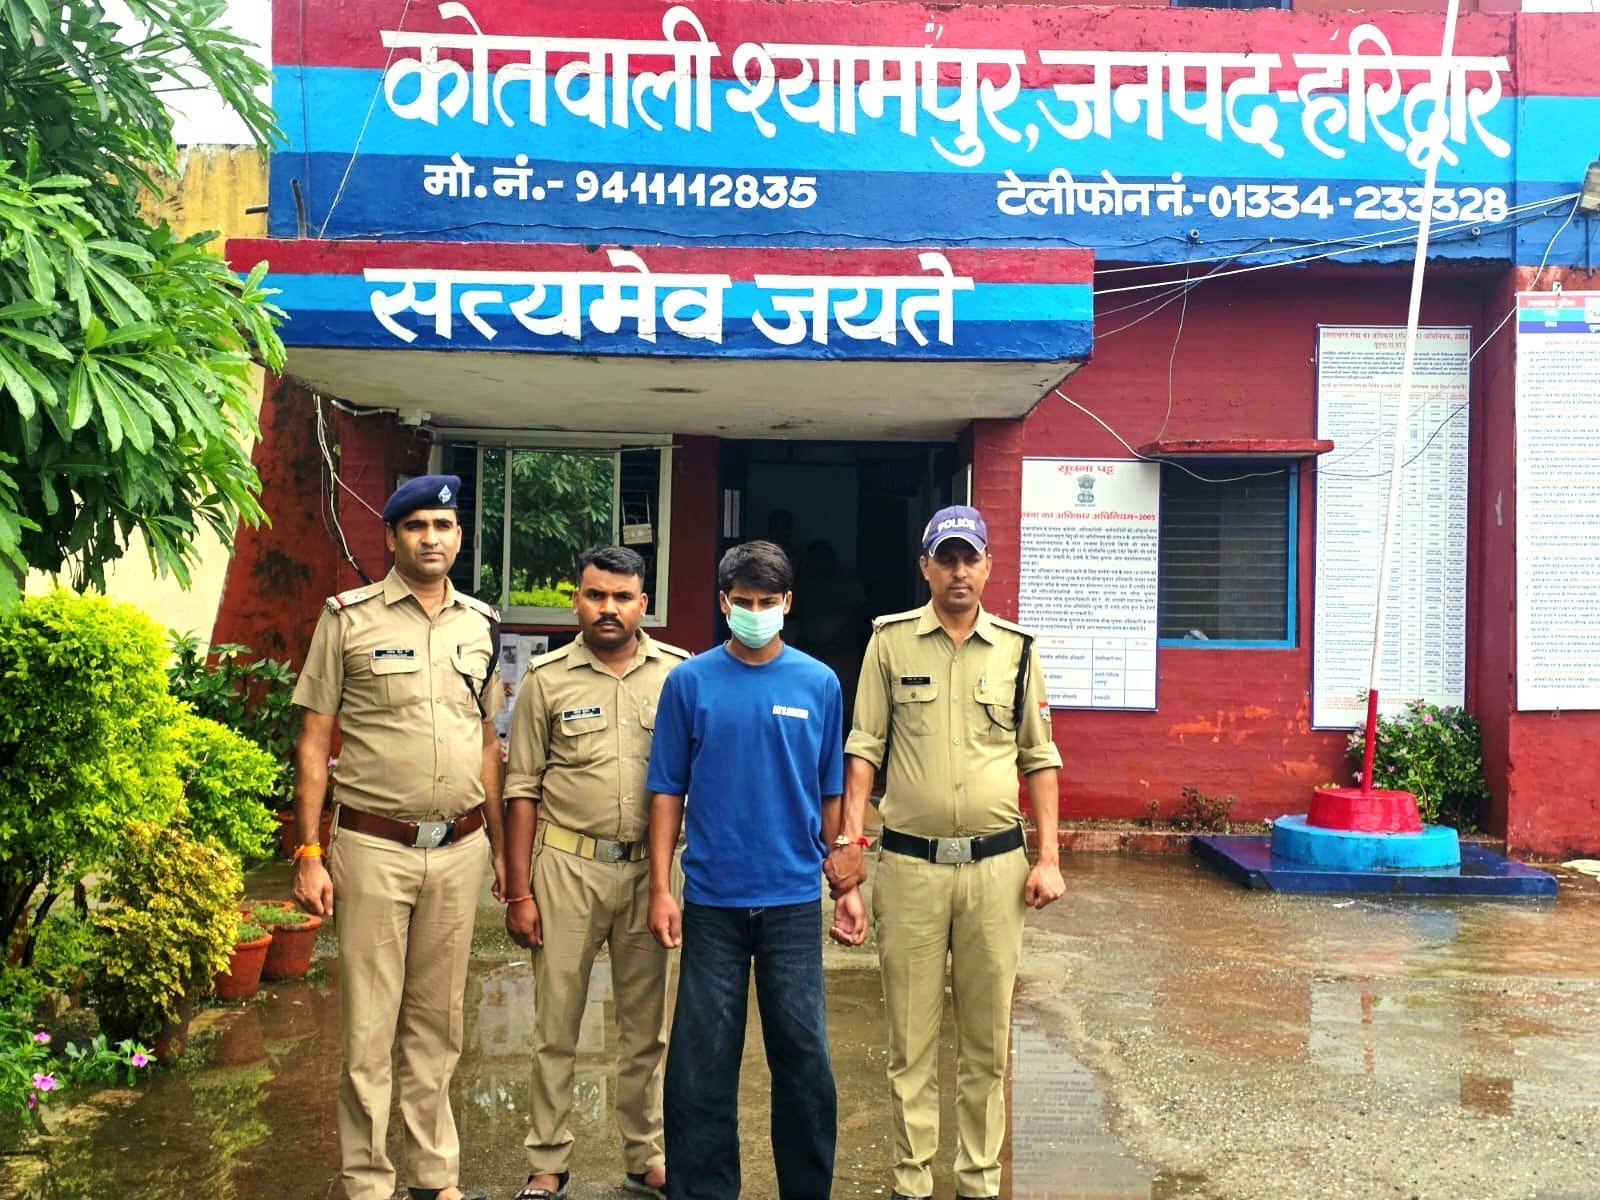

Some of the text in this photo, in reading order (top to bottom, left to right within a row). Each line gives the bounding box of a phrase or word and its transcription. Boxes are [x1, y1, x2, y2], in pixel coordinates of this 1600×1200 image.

[380, 2, 720, 132] कोतवाली
[575, 169, 818, 210] 9411112835
[363, 249, 975, 346] सत्यमेव जयते
[1058, 465, 1093, 476] सूचना
[938, 518, 976, 532] POLICE
[1056, 511, 1090, 520] अधिकार
